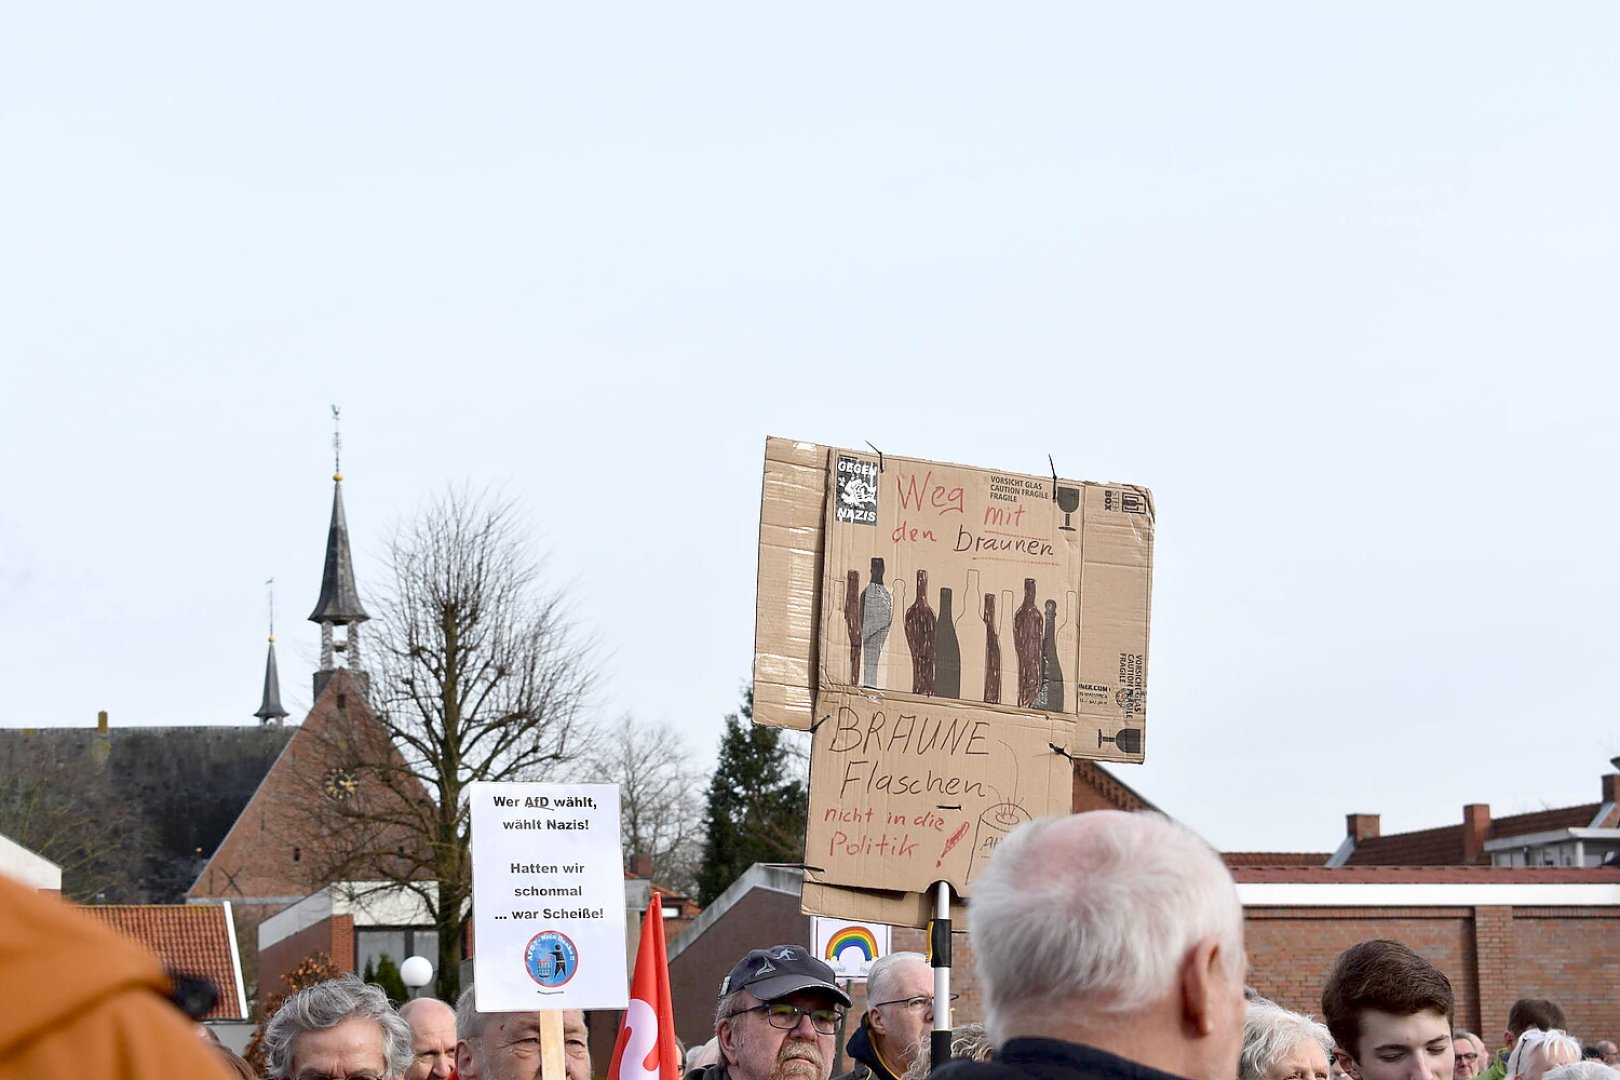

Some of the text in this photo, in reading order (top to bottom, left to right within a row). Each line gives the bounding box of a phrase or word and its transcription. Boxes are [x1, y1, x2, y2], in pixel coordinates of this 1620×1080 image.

[837, 461, 877, 475] GEGEN
[990, 476, 1043, 490] VORSICHT GLAS
[897, 470, 1026, 527] Weg mit
[989, 492, 1018, 502] FRAGILE
[990, 484, 1049, 499] CAUTION FRAGILE
[837, 508, 877, 522] NAZIS
[892, 520, 1054, 556] den braunen
[1119, 652, 1127, 683] FRAGILE
[1127, 653, 1135, 687] CAUTION
[828, 707, 990, 755] BRAUNE
[840, 760, 986, 798] Flaschen
[493, 796, 597, 810] Wer AfD wählt,
[503, 819, 589, 830] wählt Nazis!
[824, 807, 945, 832] nicht in die
[829, 831, 919, 858] Politik
[511, 862, 585, 874] Hatten wir
[514, 885, 582, 897] schonmal
[512, 909, 539, 920] war
[543, 908, 604, 919] Scheiße!
